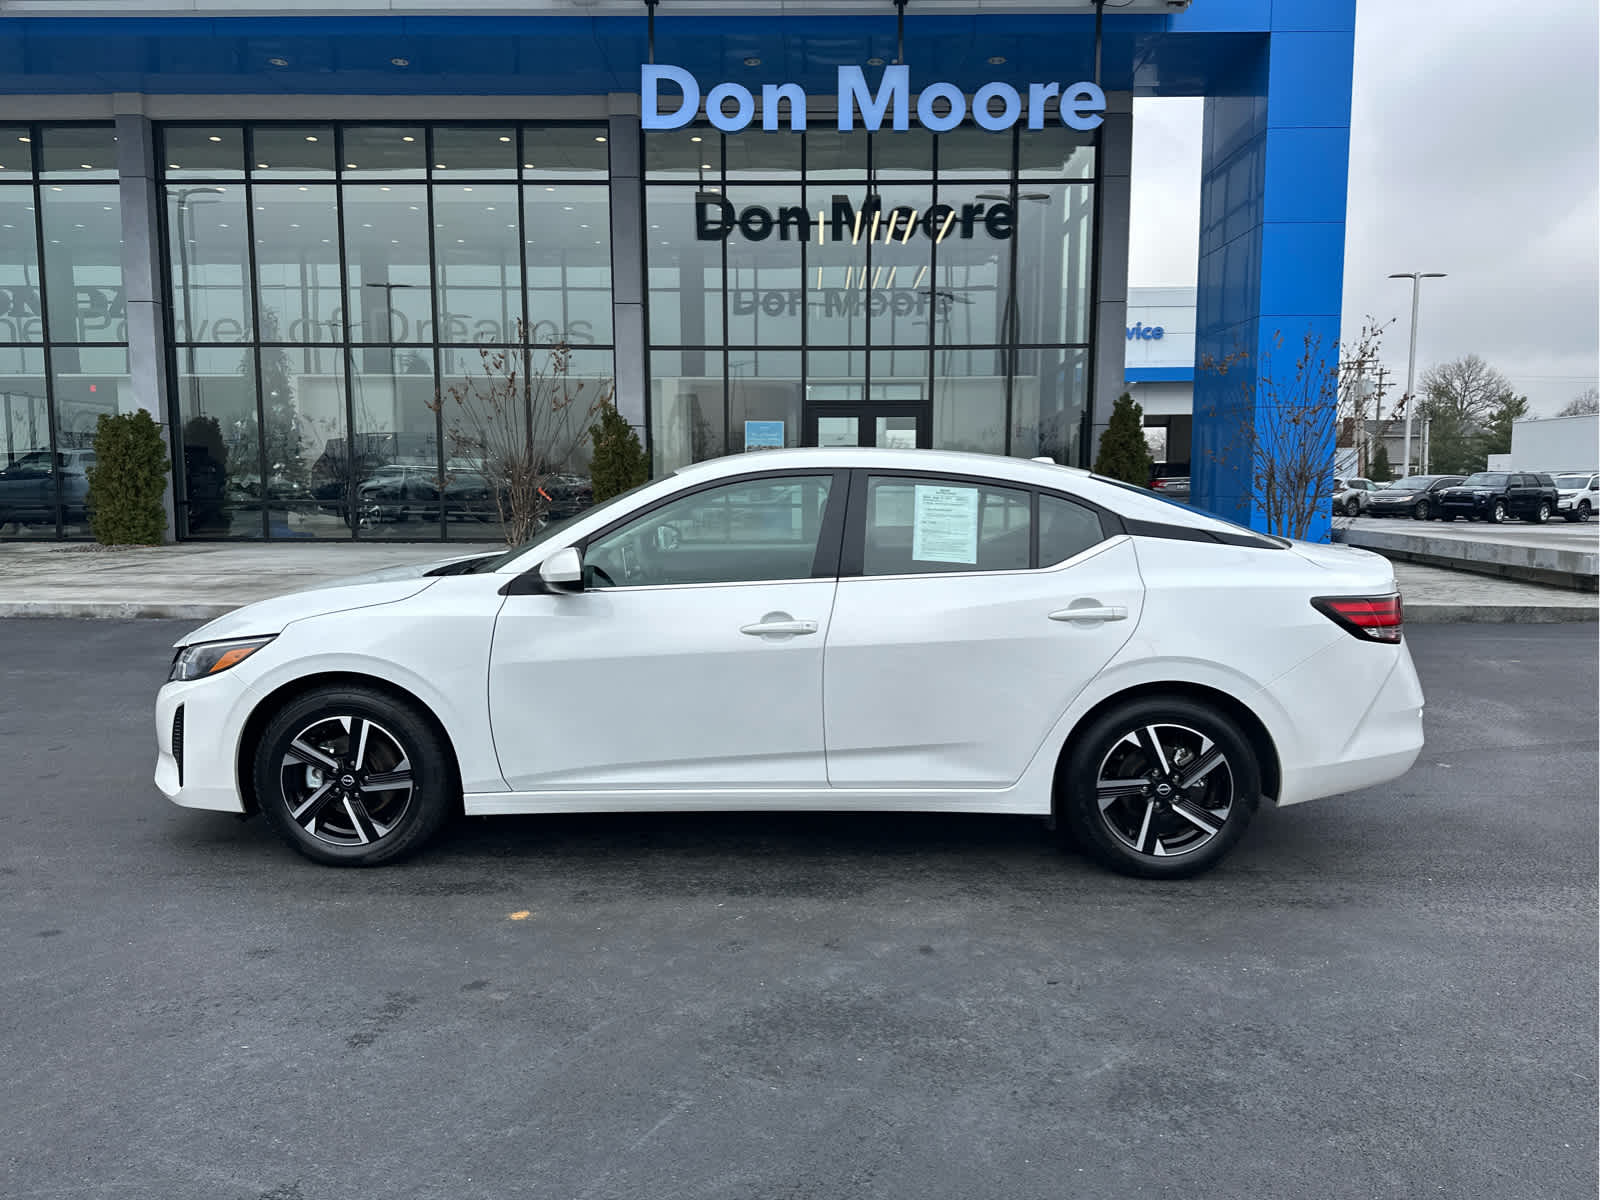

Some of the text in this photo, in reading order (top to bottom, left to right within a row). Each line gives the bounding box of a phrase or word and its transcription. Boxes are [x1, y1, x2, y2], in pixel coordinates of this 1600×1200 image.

[641, 64, 1107, 132] Don Moore
[695, 191, 1018, 241] Don Moore
[1126, 321, 1164, 340] vice
